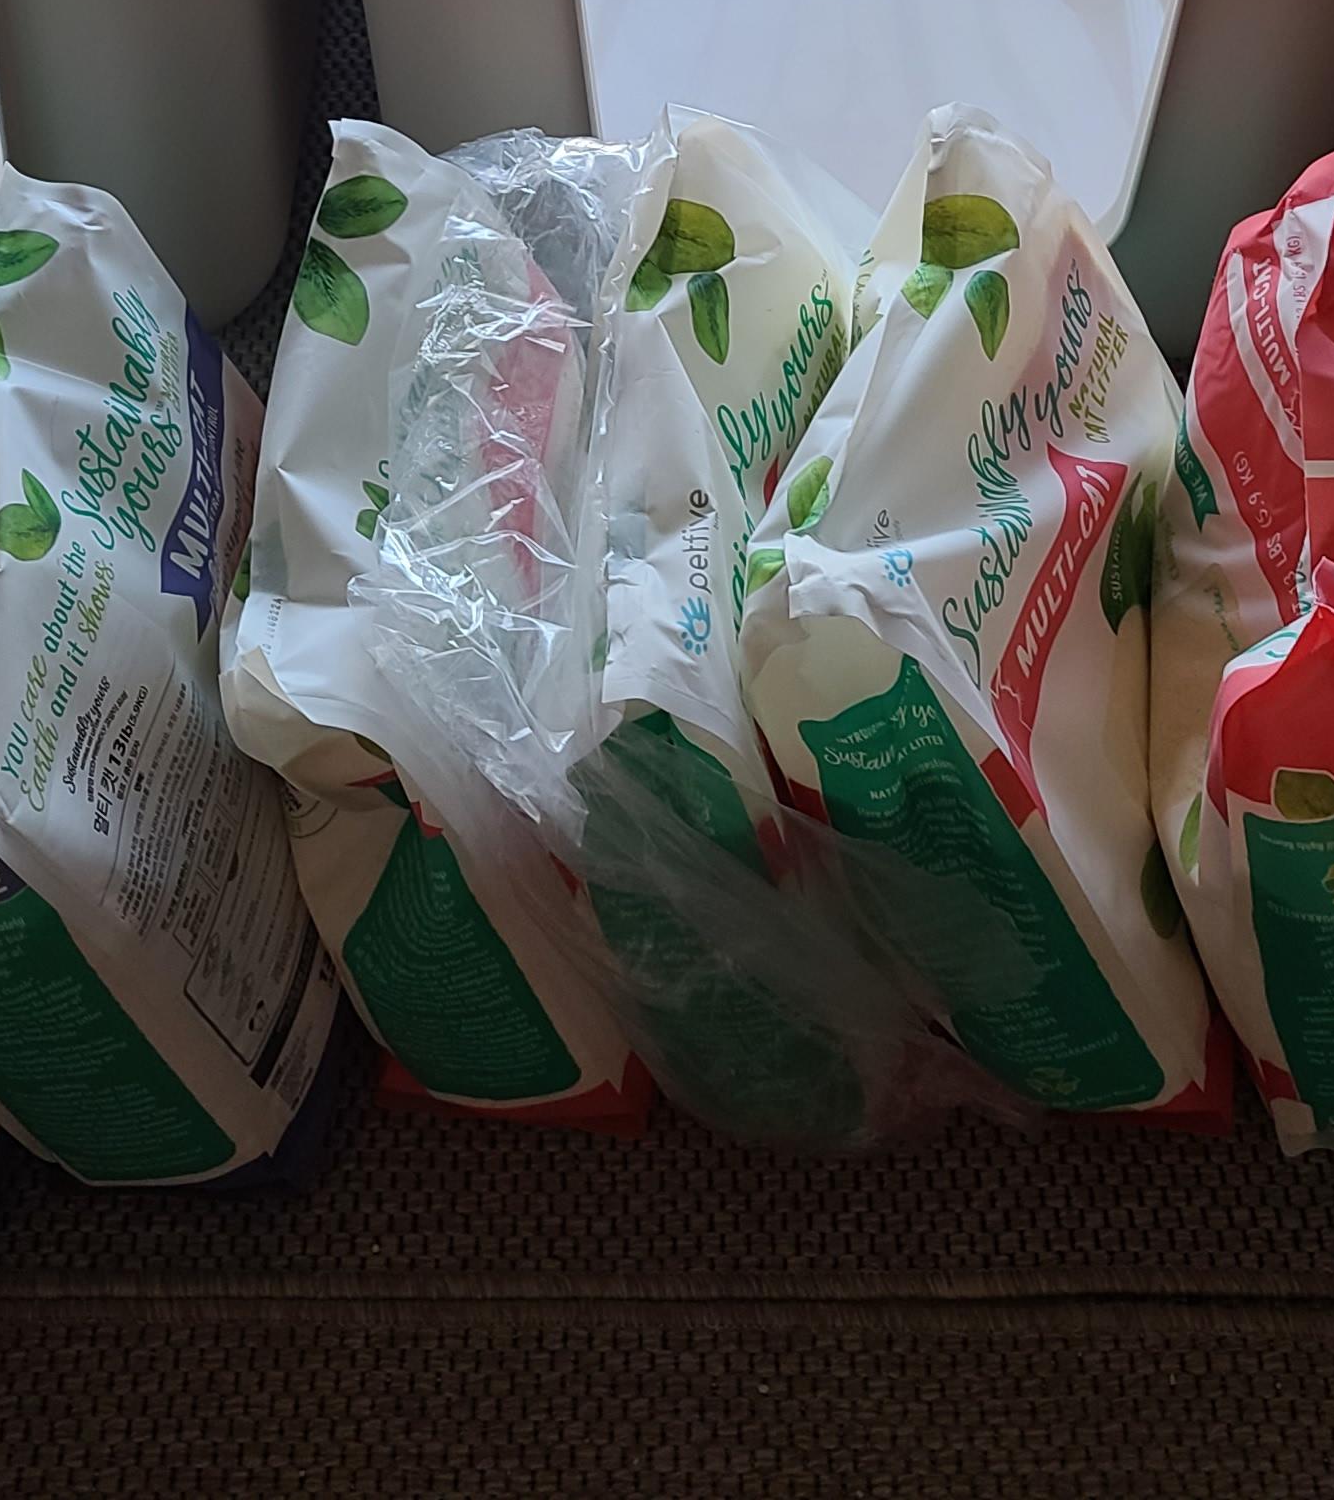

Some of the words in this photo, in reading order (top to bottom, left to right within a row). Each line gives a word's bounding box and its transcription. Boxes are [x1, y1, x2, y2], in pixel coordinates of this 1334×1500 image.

[1285, 235, 1302, 258] KG)
[771, 280, 833, 450] yours
[1034, 268, 1092, 438] yours
[1067, 311, 1117, 419] NATURAL
[1094, 323, 1131, 410] LITTER
[1252, 256, 1292, 386] MULTI-CAT
[60, 283, 161, 552] Sustainably
[1085, 409, 1111, 444] CAT
[1233, 451, 1255, 486] KG)
[108, 407, 183, 554] yours
[169, 369, 213, 581] MULTI-CAT
[1190, 472, 1210, 506] WE
[1248, 491, 1273, 528] (5.9
[682, 488, 713, 595] petfive
[1016, 464, 1111, 679] MULTI-CAT
[1267, 532, 1288, 567] LBS
[0, 721, 30, 780] YOU
[20, 654, 47, 723] care
[41, 577, 80, 654] about
[66, 540, 87, 580] the
[19, 718, 60, 813] Earth
[47, 663, 78, 719] and
[70, 640, 89, 668] it
[62, 711, 95, 796] Sustainably
[86, 675, 111, 723] yours
[108, 685, 150, 767] 13lb(5.9KG)
[92, 792, 113, 837] 멀티
[99, 769, 119, 794] 캣
